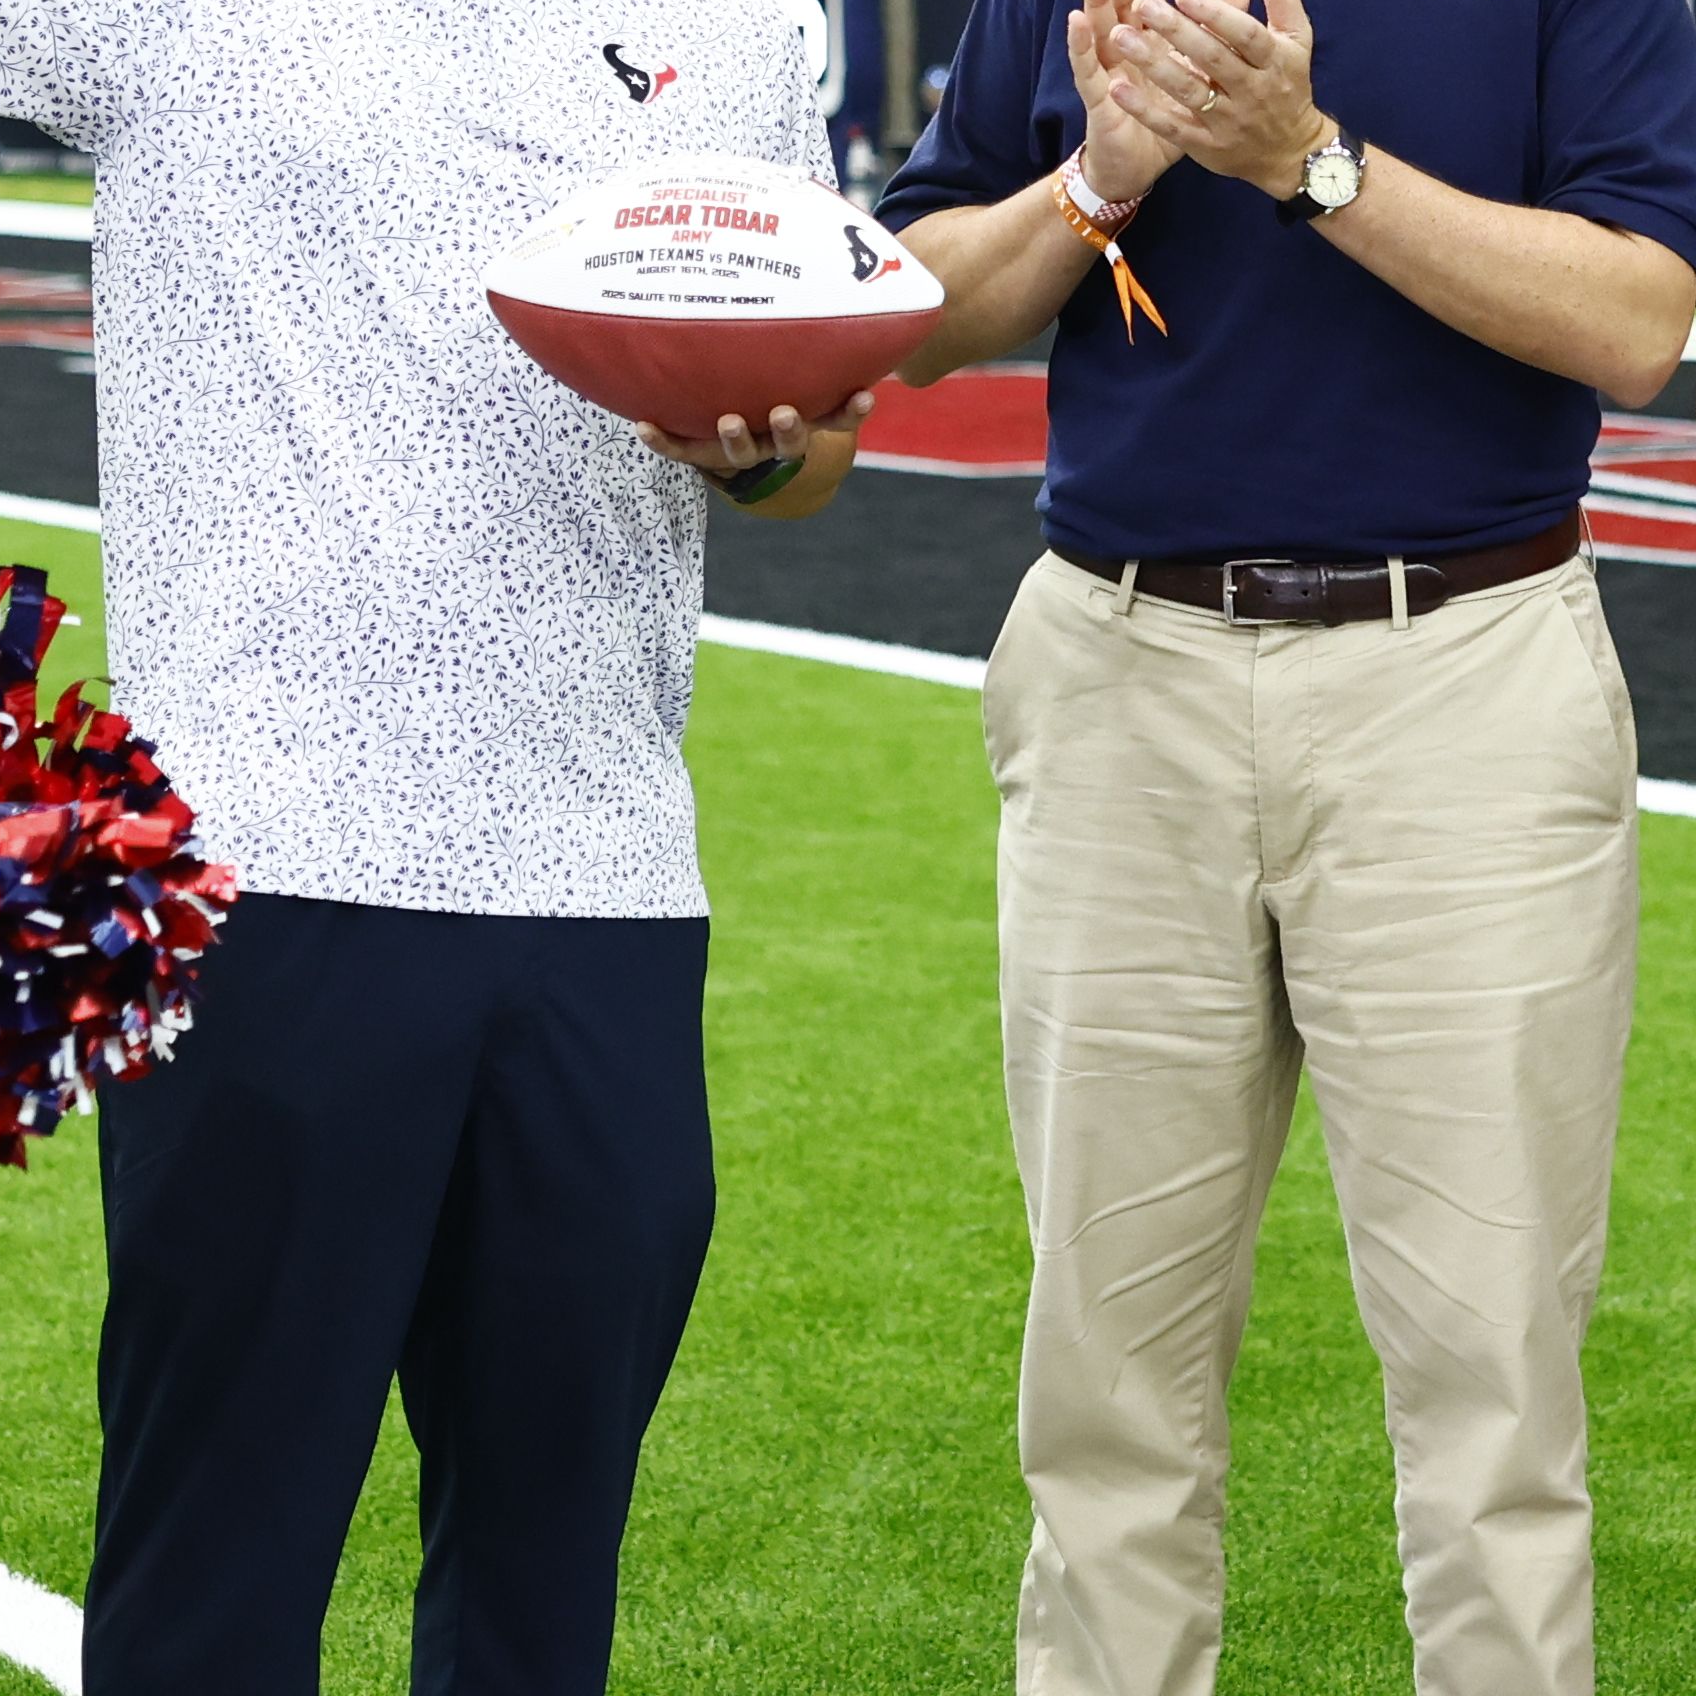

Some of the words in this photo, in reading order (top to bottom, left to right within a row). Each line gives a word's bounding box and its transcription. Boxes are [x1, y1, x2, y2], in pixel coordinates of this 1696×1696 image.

[638, 178, 664, 189] GAME
[695, 176, 753, 190] PRESENTED
[756, 185, 769, 194] TO
[651, 188, 749, 204] SPECIALIST
[614, 204, 693, 230] OSCAR
[701, 205, 780, 236] TOBAR
[671, 229, 713, 244] ARMY
[584, 250, 644, 271] HOUSTON
[649, 248, 705, 262] TEXANS
[727, 252, 802, 280] PANTHERS
[636, 265, 677, 276] AUGUST
[681, 266, 708, 276] 16TH,
[711, 268, 740, 279] 2025
[601, 289, 626, 300] 2025
[628, 291, 665, 302] SALUTE
[668, 294, 682, 303] TO
[684, 294, 728, 305] SERVICE
[730, 296, 776, 305] MOMENT
